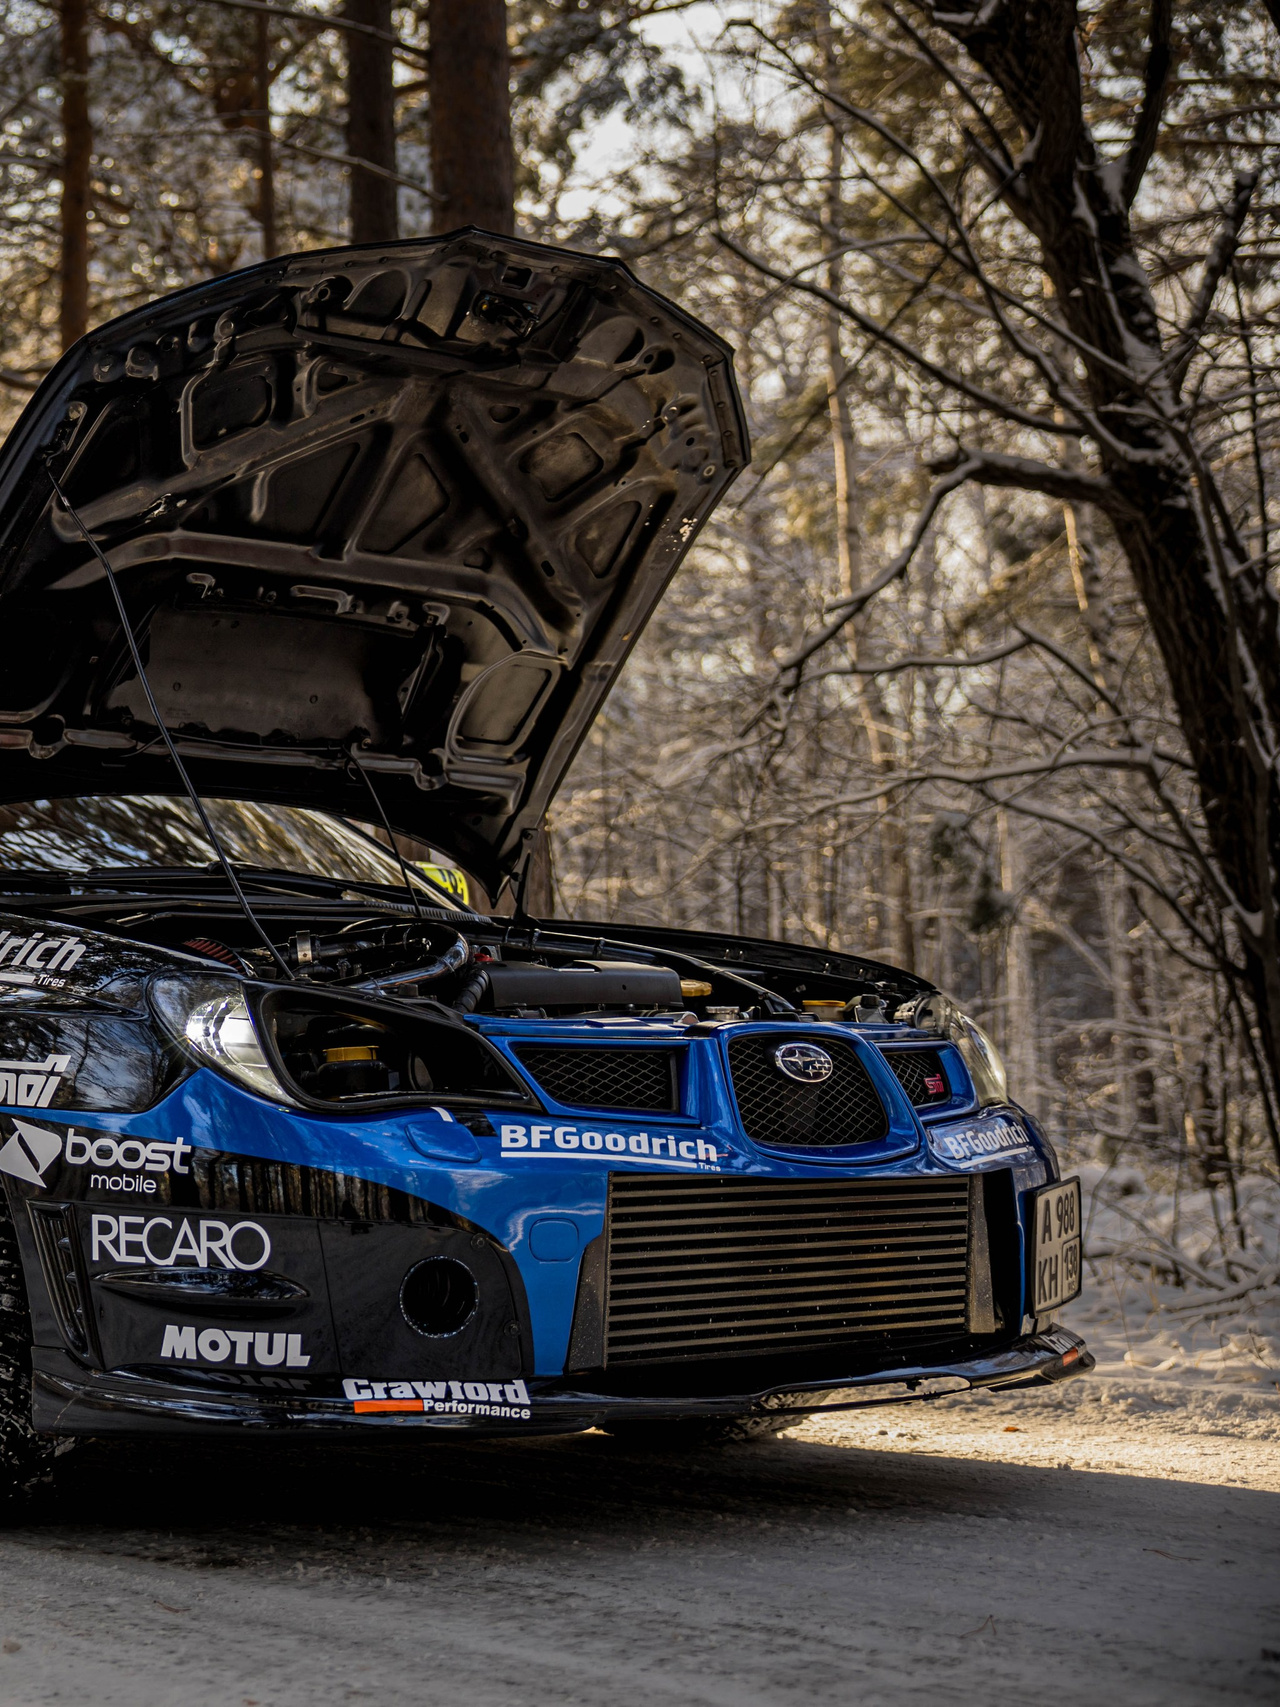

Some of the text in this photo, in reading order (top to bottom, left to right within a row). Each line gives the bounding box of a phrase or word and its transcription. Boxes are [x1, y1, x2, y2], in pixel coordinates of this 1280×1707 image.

[37, 974, 66, 988] Tires
[65, 1128, 192, 1174] boost
[500, 1124, 718, 1162] BFGoodrich
[944, 1121, 1030, 1160] BFGoodrich
[90, 1173, 157, 1193] mobile
[698, 1162, 721, 1172] Tires
[1041, 1190, 1075, 1244] A 988
[91, 1214, 271, 1271] RECARO
[1064, 1244, 1078, 1280] 138
[161, 1325, 311, 1367] MOTUL
[342, 1378, 531, 1405] Crawford
[422, 1400, 531, 1419] Performance
